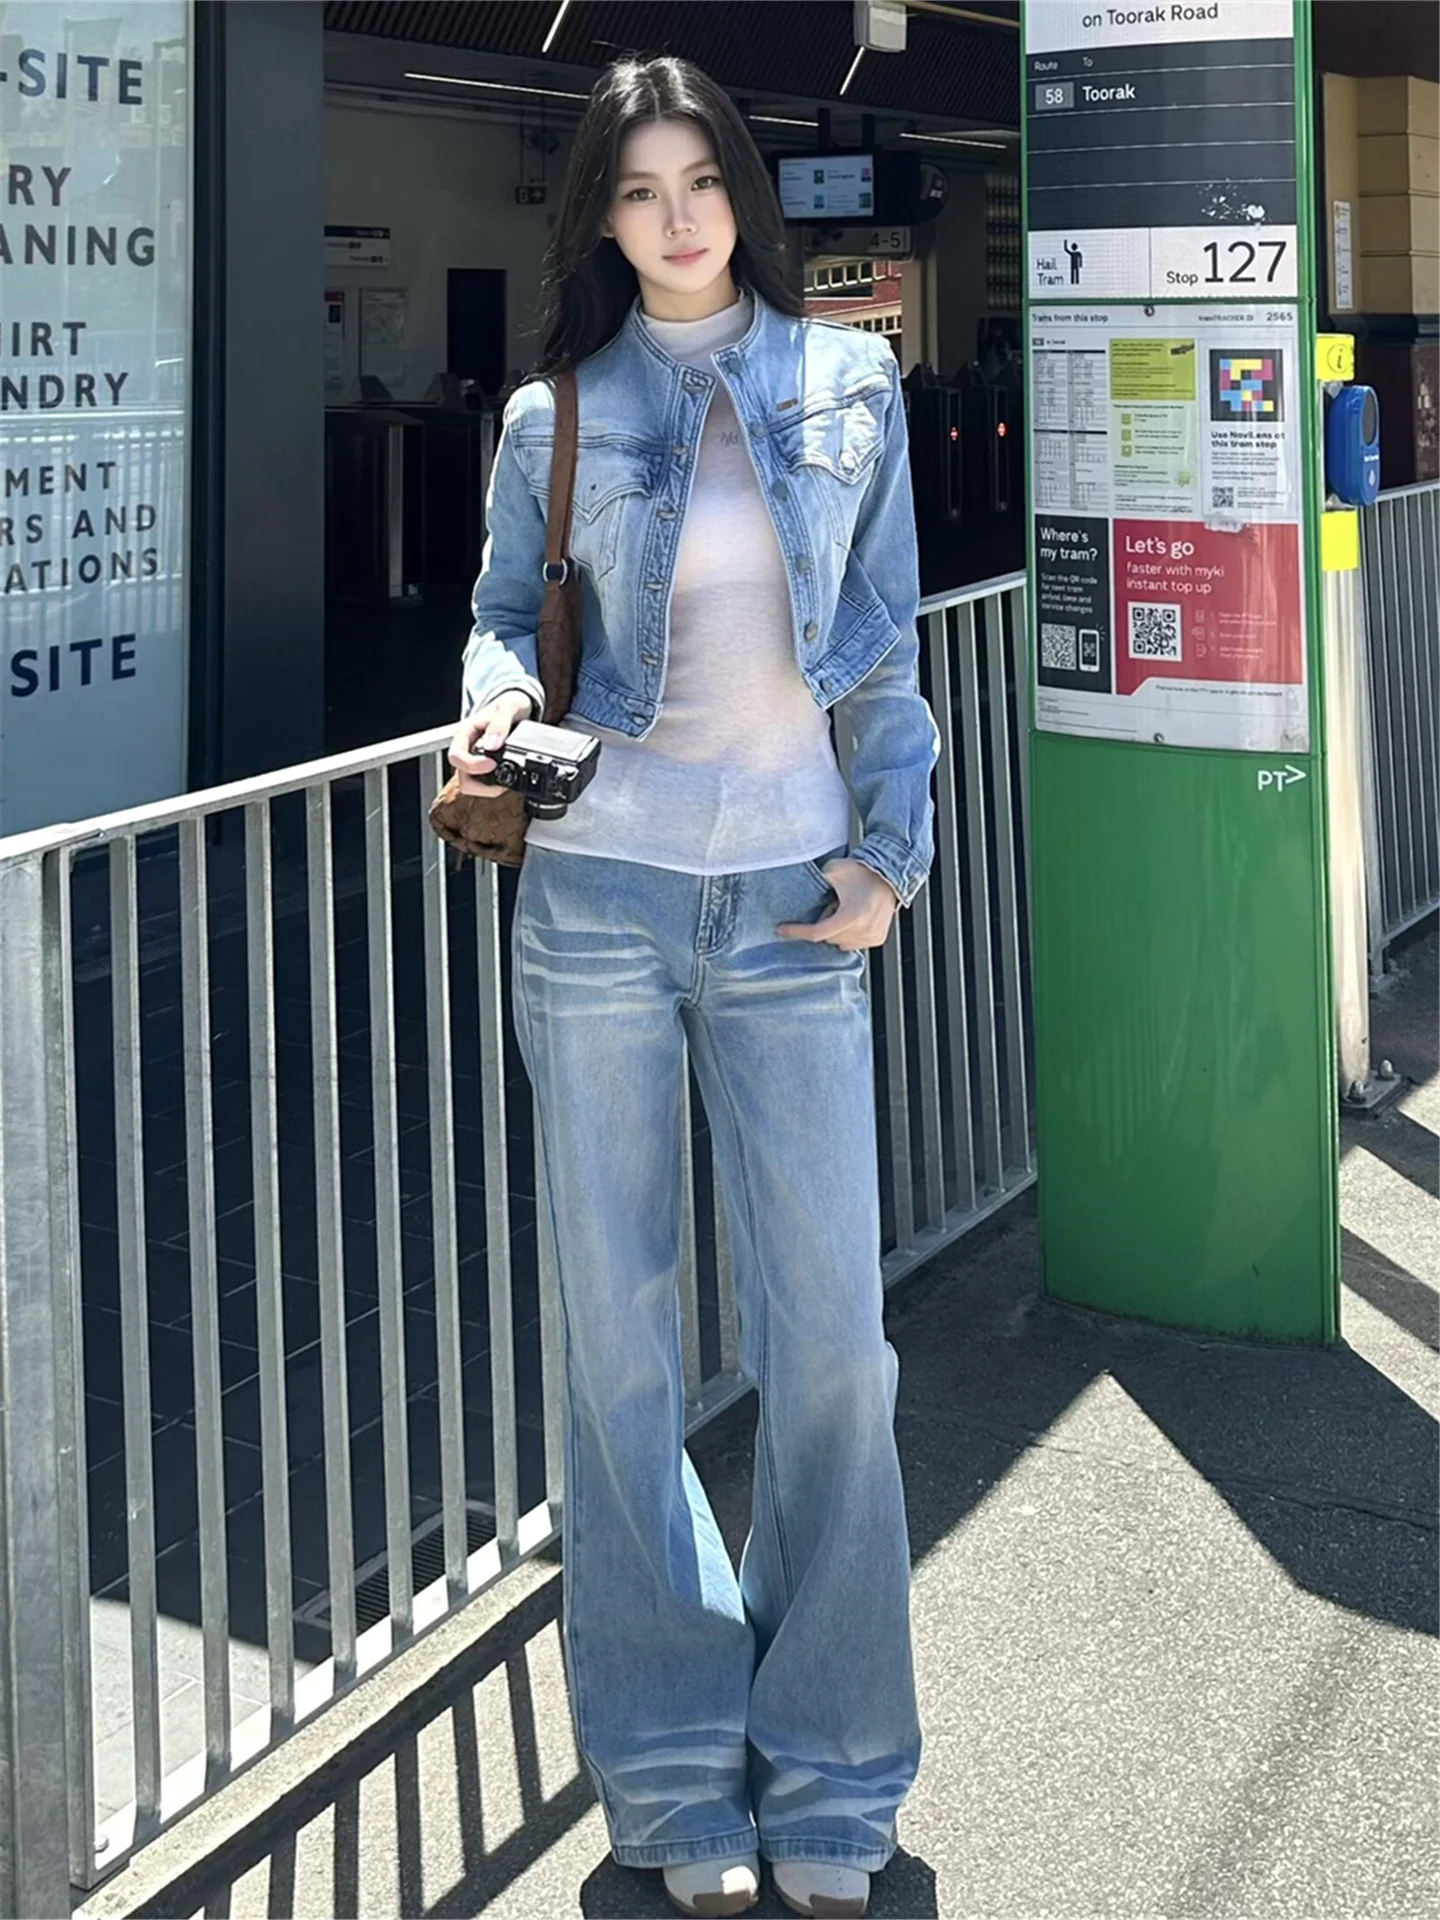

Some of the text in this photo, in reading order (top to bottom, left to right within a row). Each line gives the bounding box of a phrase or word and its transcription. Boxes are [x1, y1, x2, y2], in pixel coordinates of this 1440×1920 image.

[1082, 3, 1219, 28] on Toorak Road
[1034, 57, 1094, 72] Route To
[1045, 83, 1136, 104] 58 Toorak
[8, 164, 72, 206] RY
[871, 232, 900, 249] 4-5
[1037, 258, 1057, 271] Hail
[1203, 241, 1287, 283] 127
[1037, 273, 1064, 285] Tram
[1166, 271, 1199, 286] Stop
[1074, 313, 1088, 322] this
[1090, 314, 1109, 323] stop
[1266, 311, 1293, 321] 2565
[1, 372, 128, 411] NDRY
[1211, 431, 1228, 439] Use
[1256, 441, 1277, 449] stop
[5, 461, 116, 498] MENT
[72, 504, 156, 539] AND
[1040, 527, 1089, 543] Where's
[1040, 548, 1098, 561] my tram?
[1126, 535, 1194, 559] Let's go
[4, 547, 158, 594] ATIONS
[1126, 561, 1224, 580] faster with myki
[1126, 577, 1212, 595] instant top up
[10, 634, 136, 698] SITE
